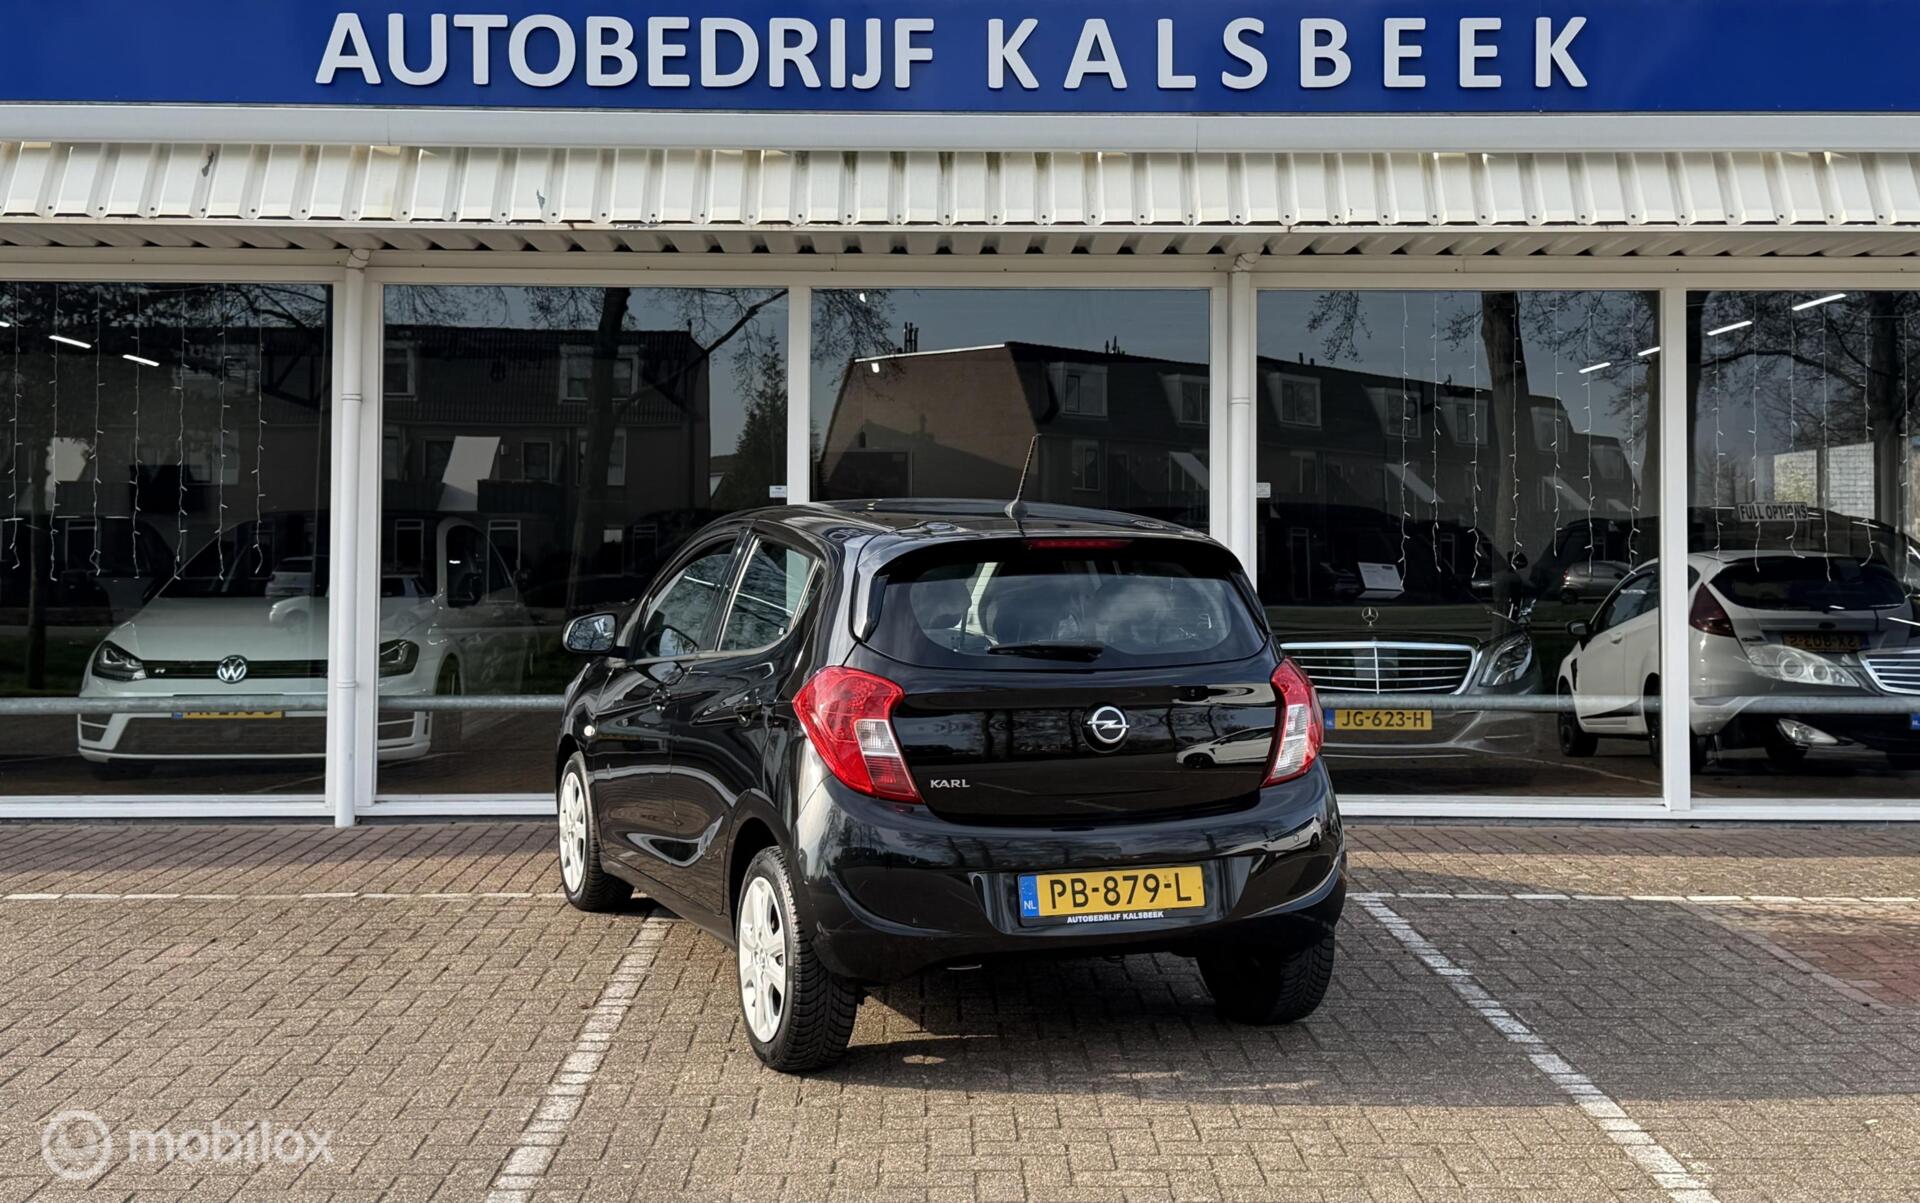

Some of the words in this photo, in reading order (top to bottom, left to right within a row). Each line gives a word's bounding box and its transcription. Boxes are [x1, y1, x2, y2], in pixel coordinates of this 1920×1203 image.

[315, 12, 935, 90] AUTOBEDRIJF
[987, 16, 1589, 89] KALSBEEK
[1740, 505, 1764, 520] FULL
[1341, 711, 1425, 728] JG-623-H
[930, 779, 971, 789] KARL
[1049, 872, 1192, 910] PB-879-L
[1024, 900, 1037, 911] NL
[1066, 914, 1121, 924] AUTOBEDRIJF
[1122, 911, 1164, 921] KALSBEEK
